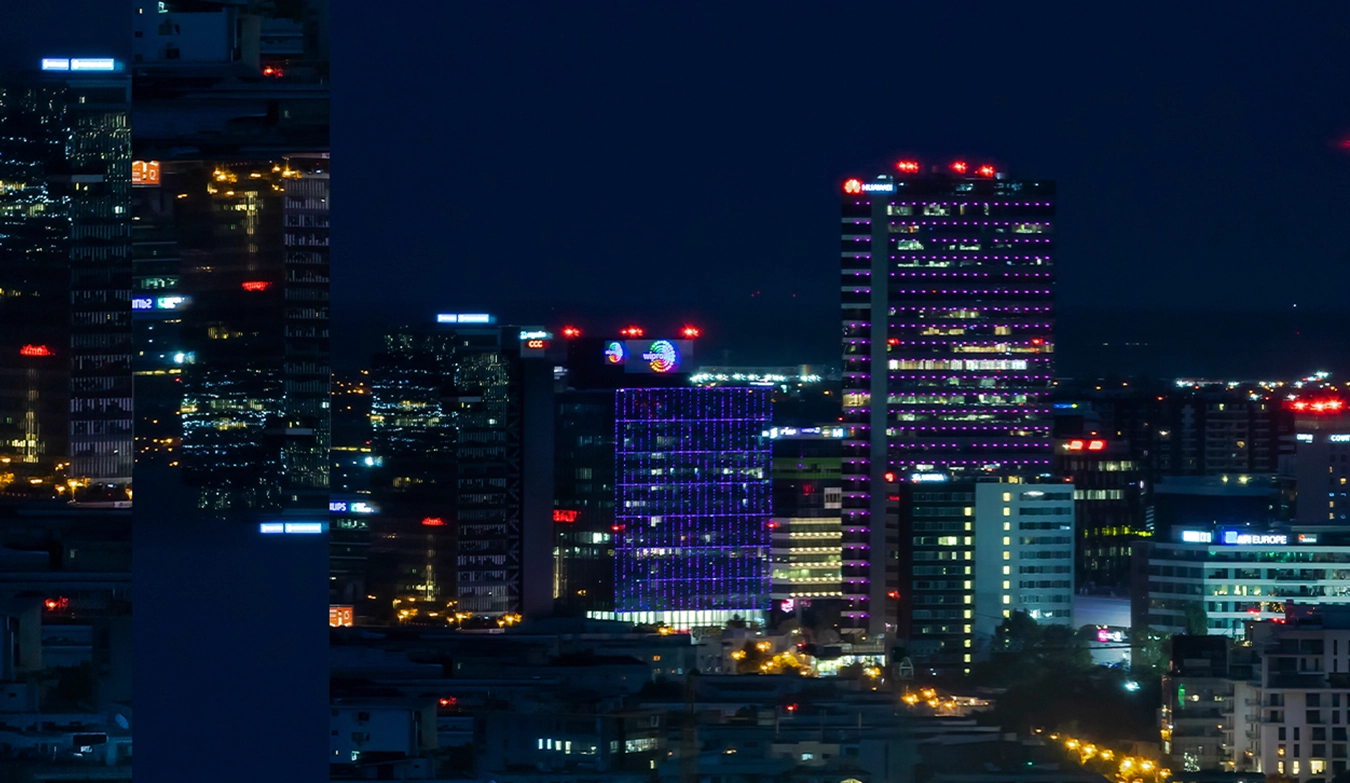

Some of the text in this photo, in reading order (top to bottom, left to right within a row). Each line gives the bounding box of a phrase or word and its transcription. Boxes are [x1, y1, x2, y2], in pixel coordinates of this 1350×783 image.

[861, 184, 893, 192] HUAWEI
[529, 340, 543, 348] CCC
[643, 351, 664, 361] wipro
[1252, 535, 1287, 544] EUROPE
